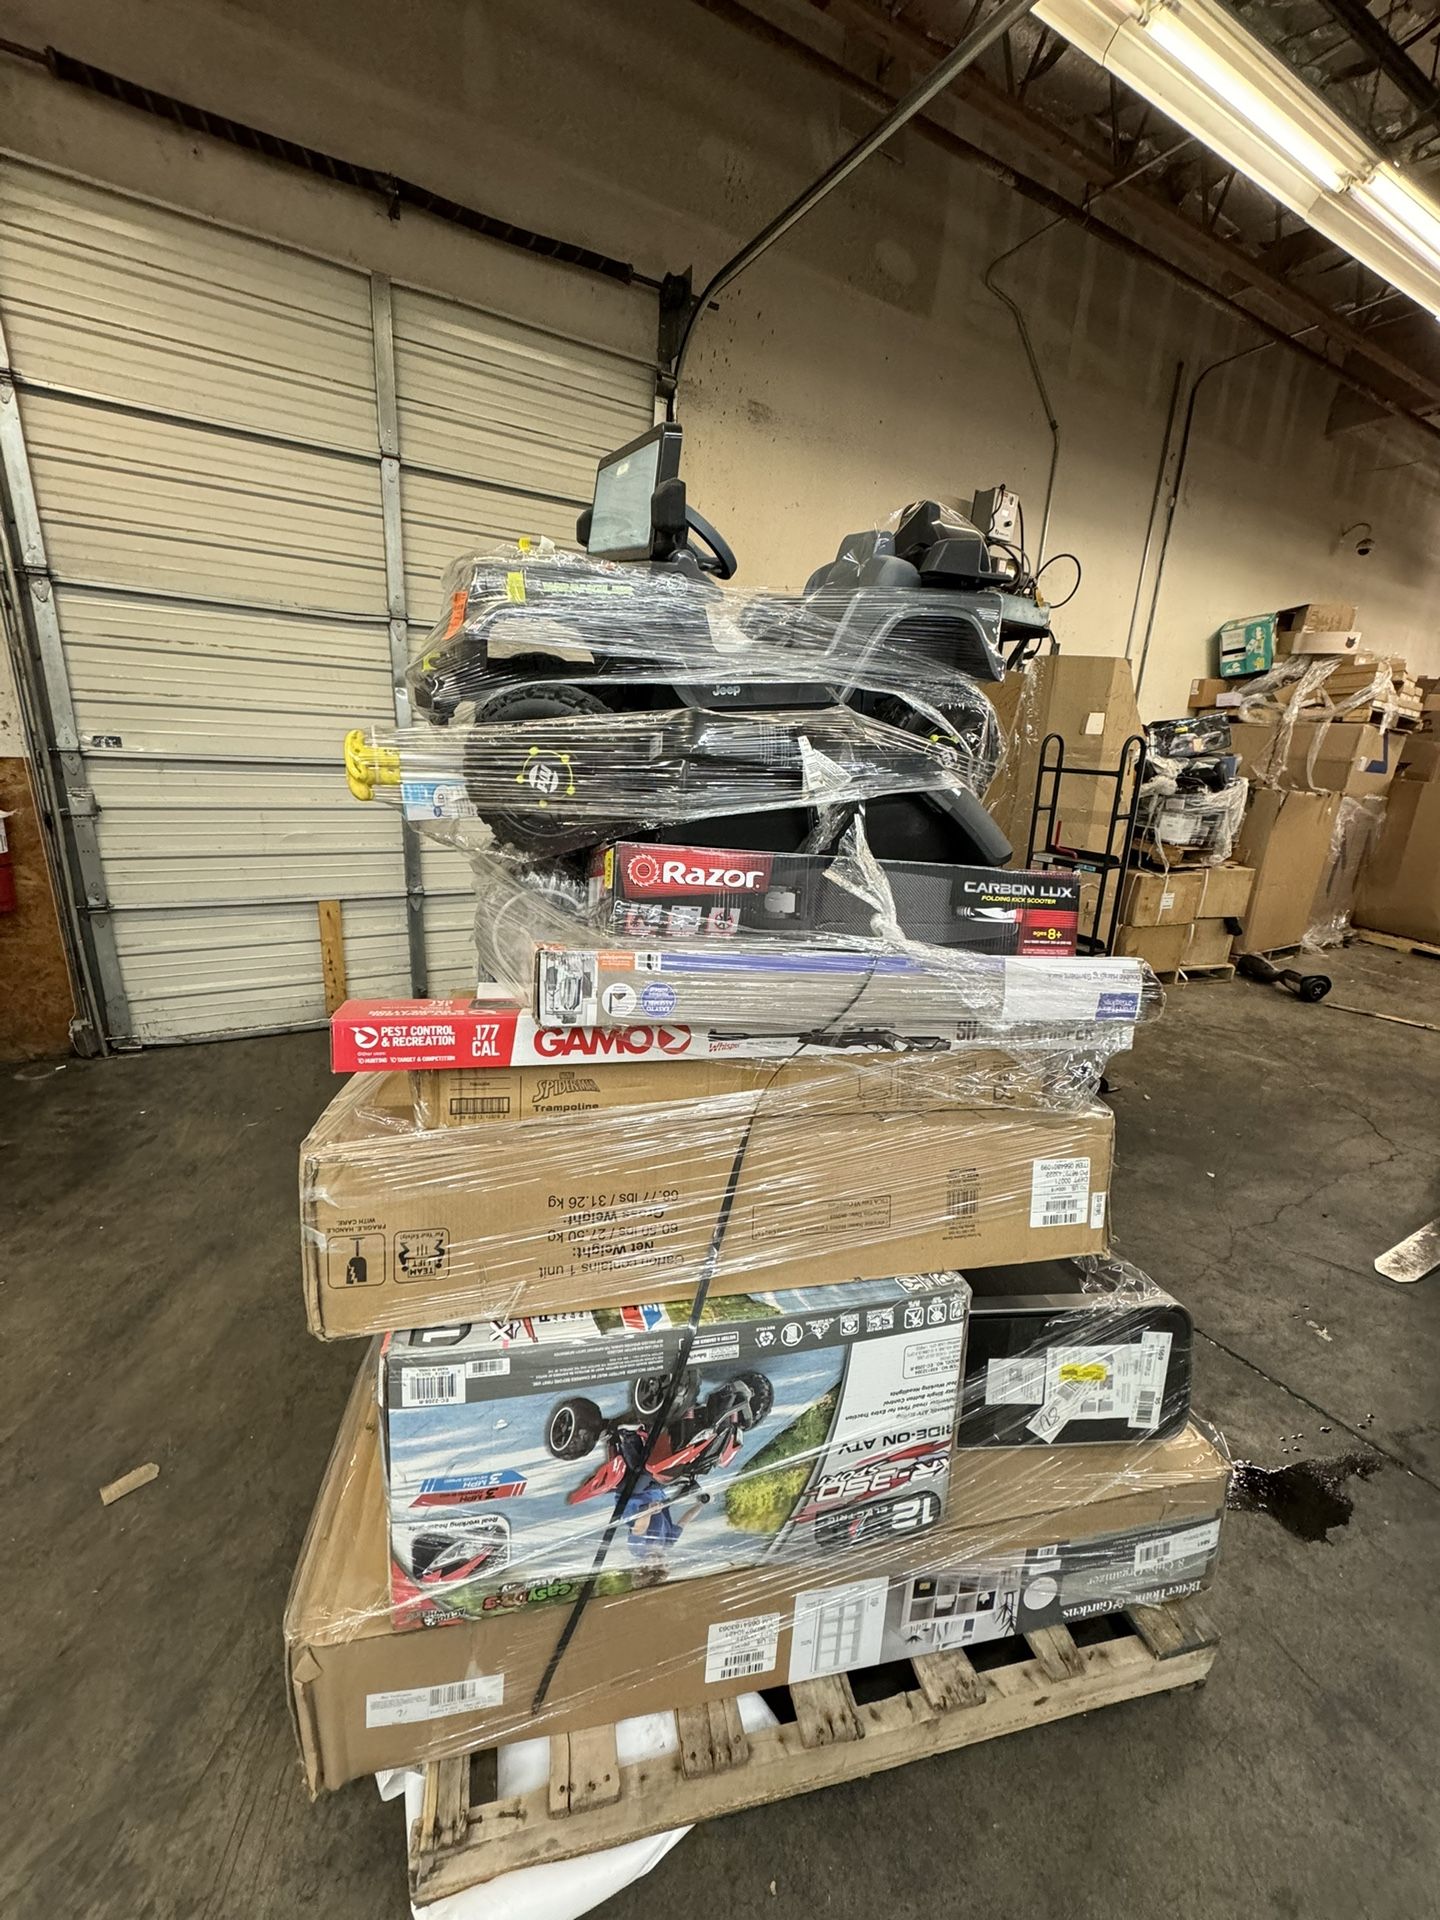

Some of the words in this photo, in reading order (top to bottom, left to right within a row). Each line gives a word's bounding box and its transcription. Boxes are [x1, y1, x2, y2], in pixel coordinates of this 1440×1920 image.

[712, 685, 741, 697] Jeep
[964, 881, 1035, 896] CARBON
[1040, 886, 1074, 898] LUX
[981, 895, 1011, 903] FOLDING
[1048, 928, 1062, 940] 8+
[381, 1027, 408, 1036] PEST
[410, 1025, 455, 1036] CONTROL
[473, 1024, 500, 1041] .177
[381, 1038, 390, 1047] &
[392, 1036, 456, 1047] RECREATION
[534, 1025, 654, 1057] GAMO
[472, 1041, 500, 1056] CAL
[709, 1042, 740, 1053] Whisper
[533, 1103, 599, 1113] Trampoline
[548, 1195, 564, 1210] kg
[568, 1195, 606, 1209] 31.26
[619, 1193, 638, 1205] lbs
[641, 1190, 679, 1203] 68.77
[547, 1230, 564, 1243] kg
[572, 1244, 626, 1258] Weight:
[631, 1241, 654, 1252] Net
[409, 1267, 434, 1275] TEAM
[538, 1265, 564, 1279] unit
[570, 1265, 575, 1276] 1
[890, 1387, 921, 1397] Headlights
[922, 1383, 945, 1392] Working
[927, 1390, 944, 1399] Single
[883, 1398, 905, 1406] Control
[845, 1412, 869, 1420] Traction
[838, 1437, 876, 1455] ATV
[489, 1472, 504, 1486] 3
[811, 1463, 879, 1490] SPORT
[463, 1479, 487, 1488] MPH
[459, 1494, 483, 1502] MPH
[485, 1487, 499, 1500] 3
[450, 1519, 480, 1529] working
[481, 1517, 498, 1525] Real
[528, 1583, 572, 1601] easy
[1166, 1581, 1201, 1596] Better
[1132, 1589, 1165, 1603] Hom
[1062, 1600, 1112, 1618] Gardens
